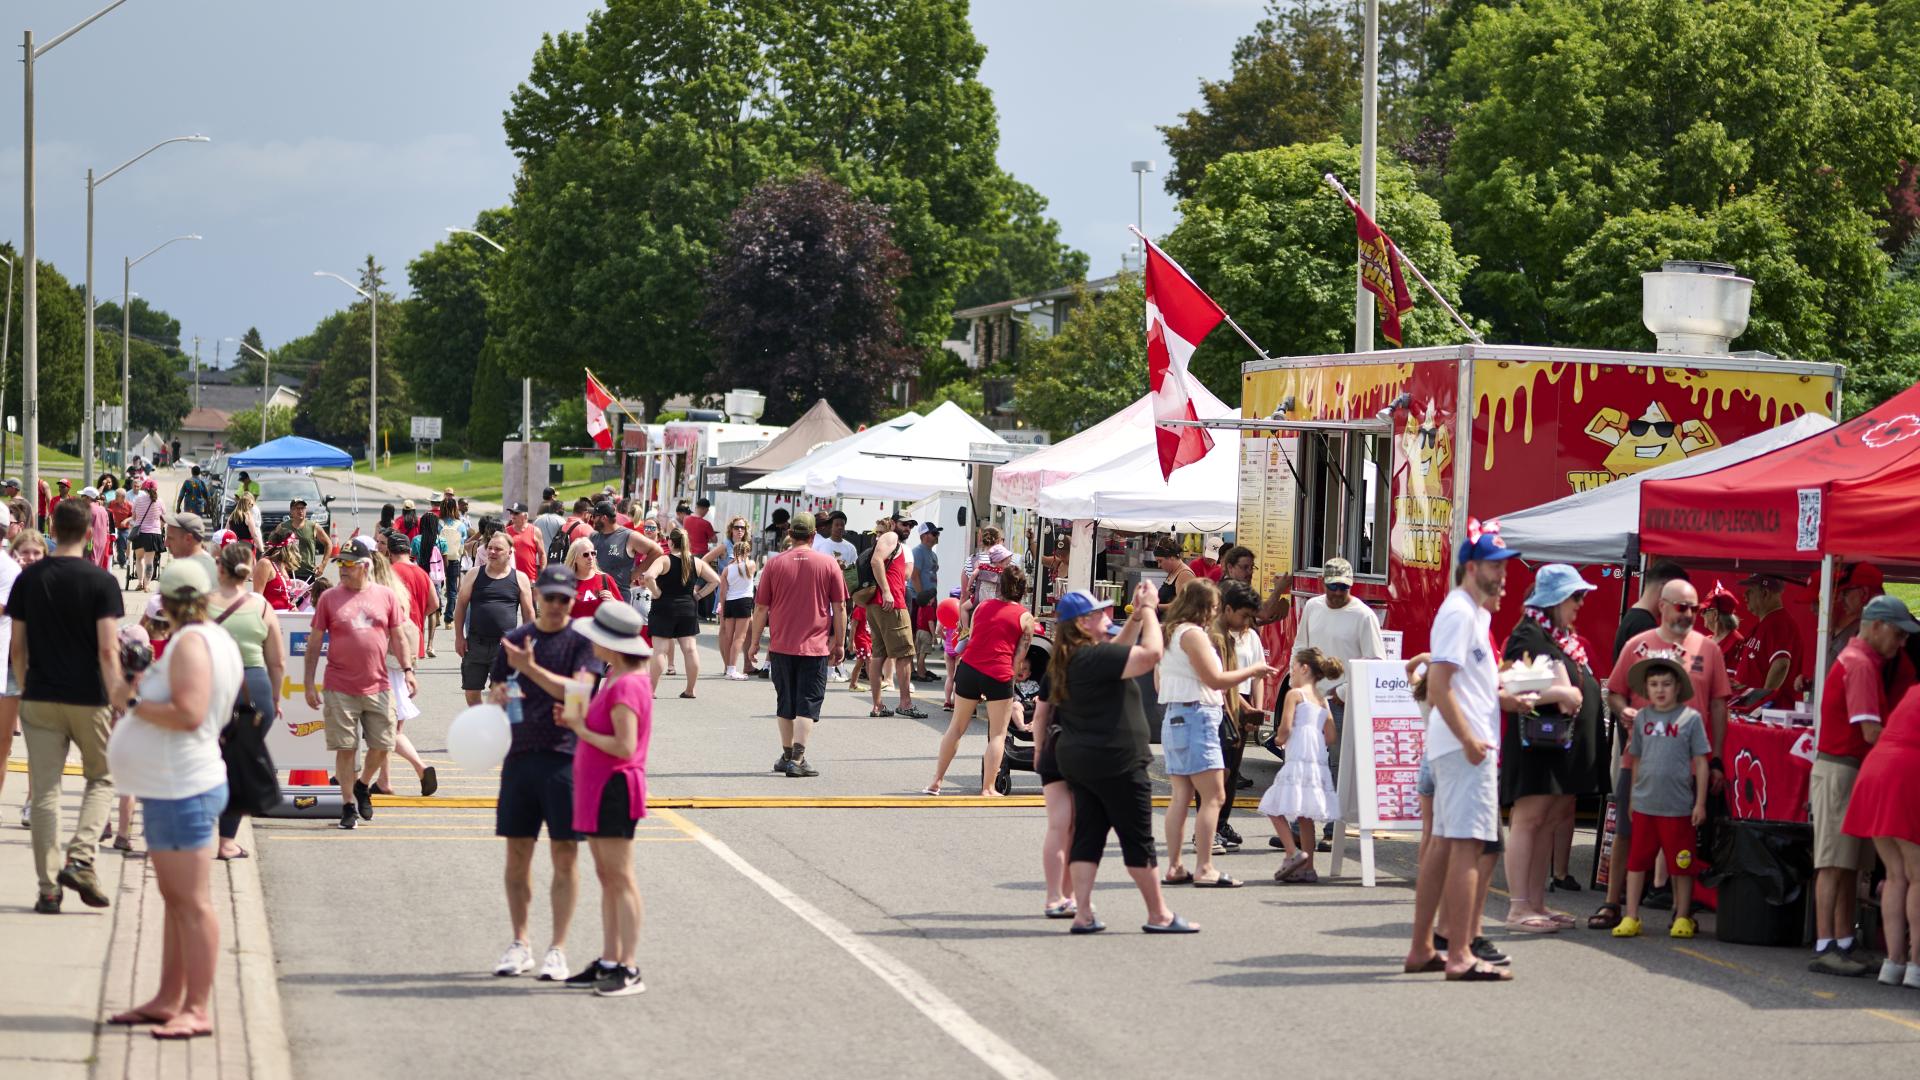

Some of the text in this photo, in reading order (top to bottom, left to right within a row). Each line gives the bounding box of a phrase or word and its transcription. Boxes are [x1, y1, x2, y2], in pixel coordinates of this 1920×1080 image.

[1568, 472, 1611, 493] THE
[1645, 508, 1780, 533] WWW.ROCKLAND-LEGION.CA
[1644, 720, 1679, 738] CAN
